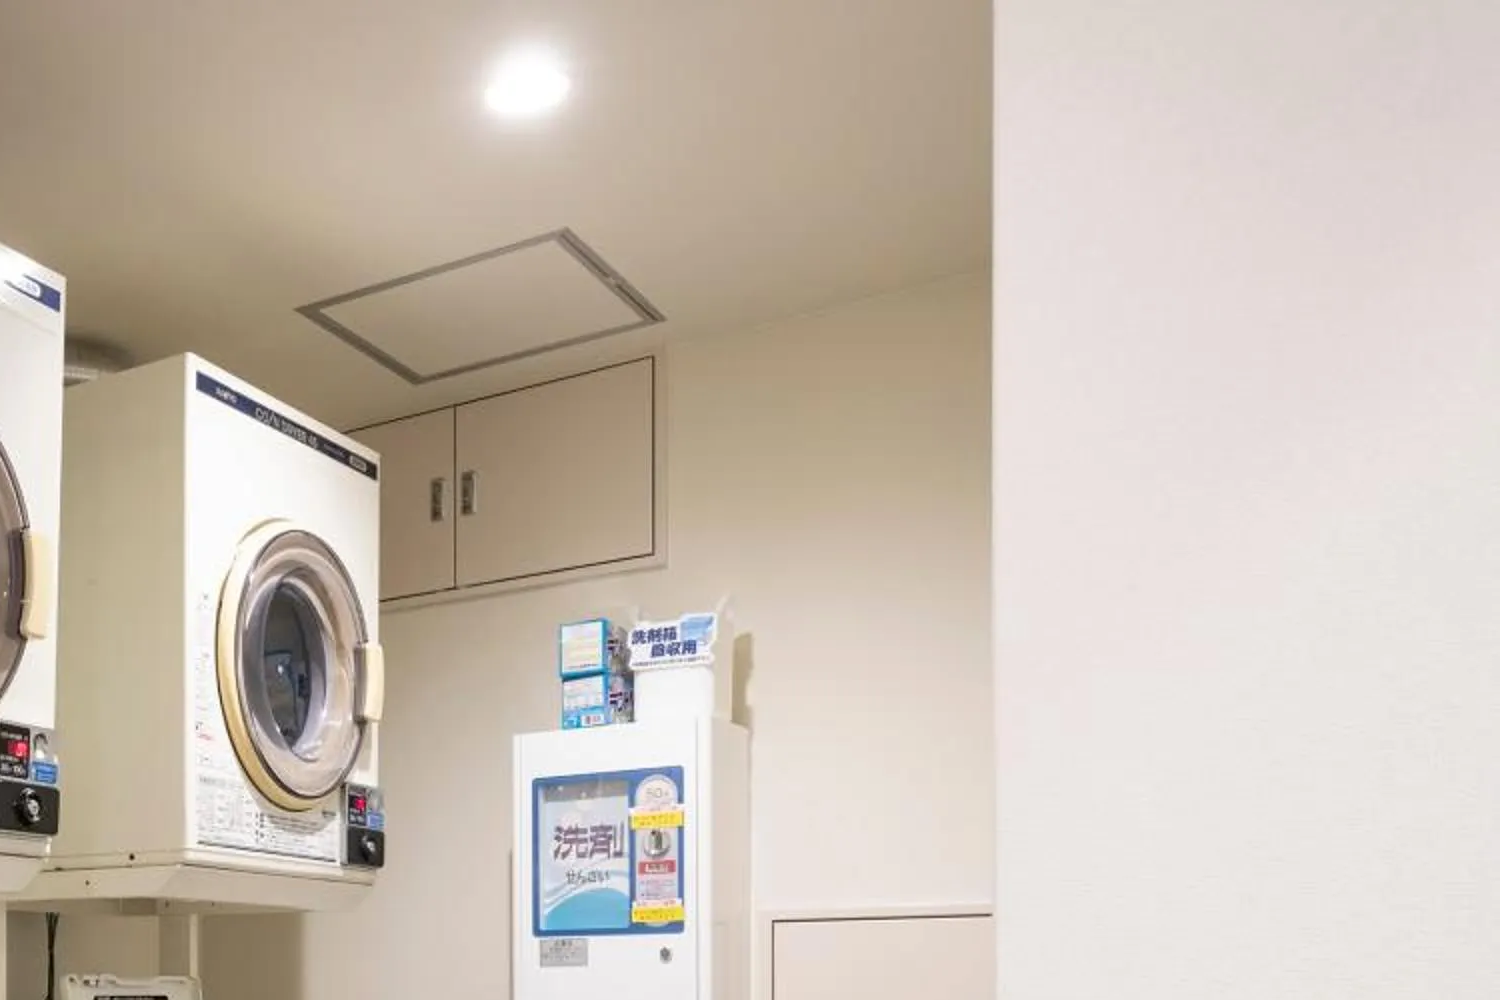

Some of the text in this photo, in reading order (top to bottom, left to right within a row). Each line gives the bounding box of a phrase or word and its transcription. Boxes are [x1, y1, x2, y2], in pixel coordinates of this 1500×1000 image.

[554, 821, 626, 861] 洗剤
[565, 869, 611, 885] せんざい
